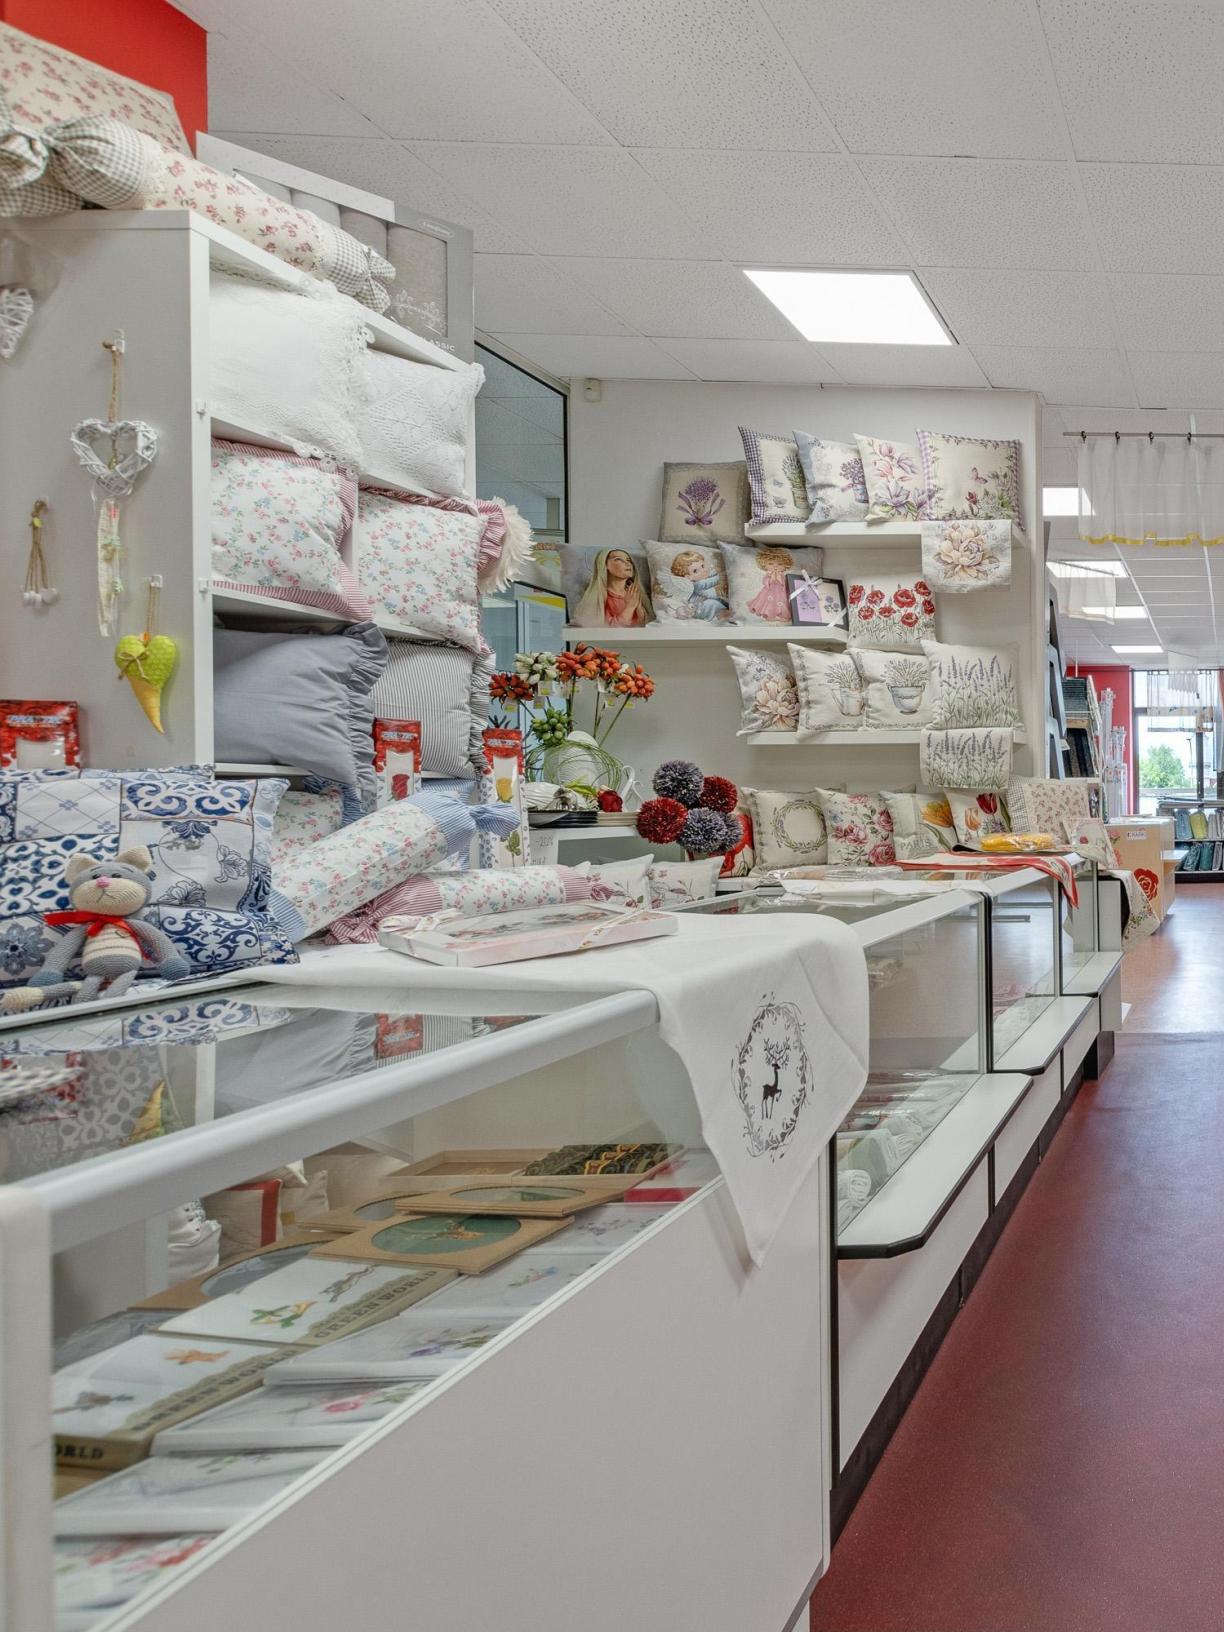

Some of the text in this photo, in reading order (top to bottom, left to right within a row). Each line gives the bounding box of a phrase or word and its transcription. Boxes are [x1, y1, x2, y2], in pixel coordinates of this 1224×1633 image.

[900, 839, 931, 851] PARIS
[314, 1270, 438, 1339] GREEN WORLD
